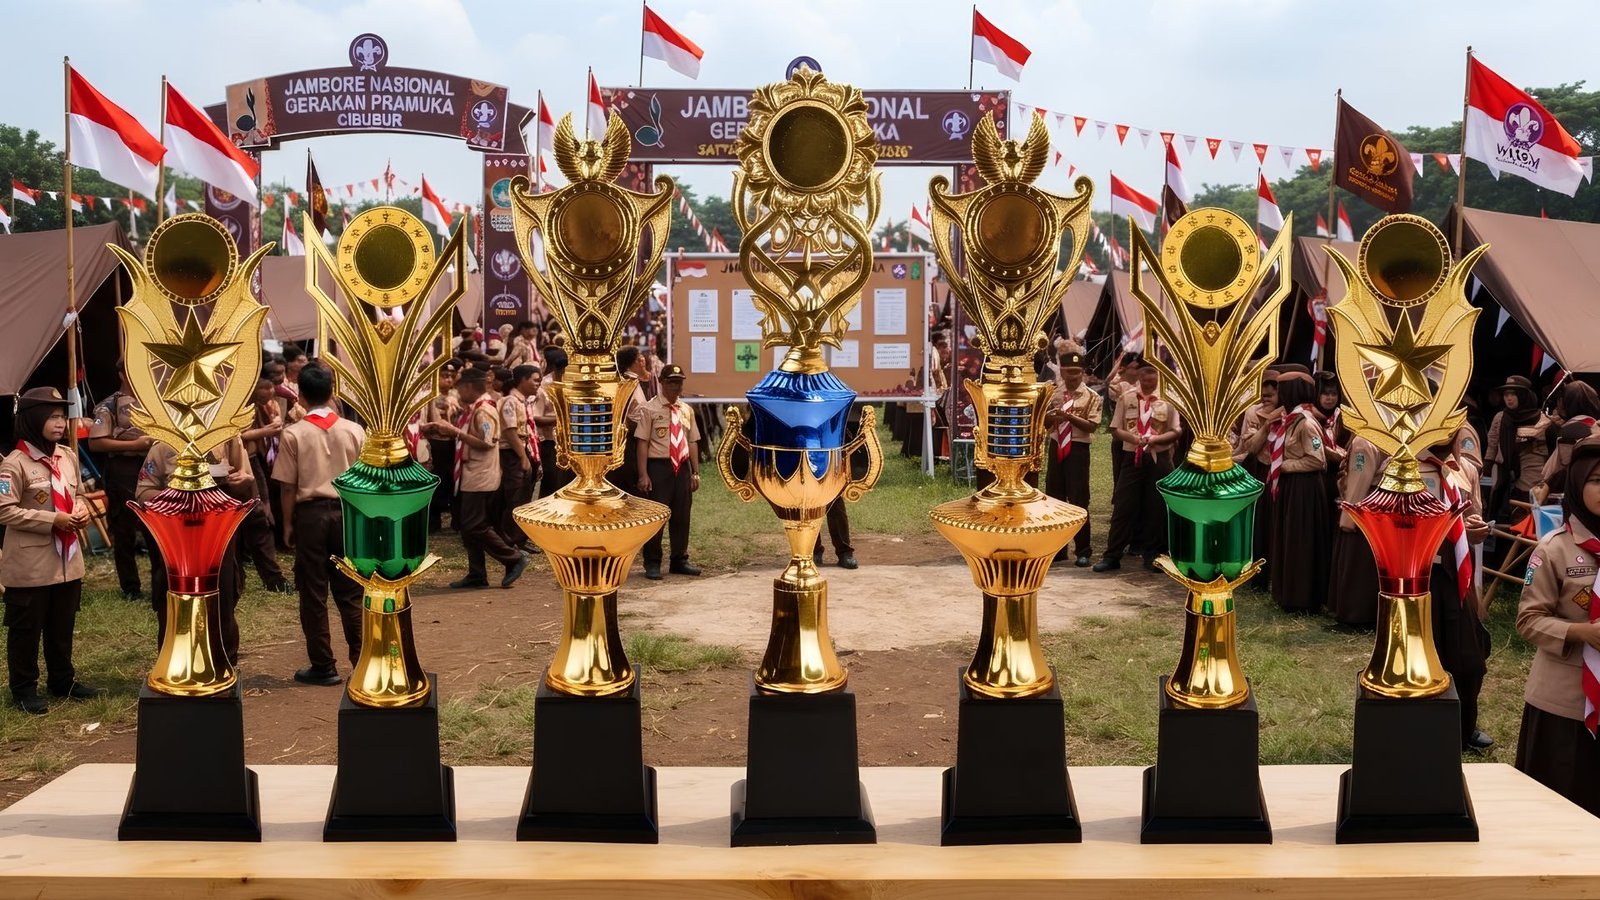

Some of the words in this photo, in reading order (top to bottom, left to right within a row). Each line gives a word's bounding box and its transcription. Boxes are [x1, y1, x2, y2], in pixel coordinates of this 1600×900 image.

[284, 76, 366, 96] JAMBORE
[370, 75, 455, 96] NASIONAL
[285, 94, 366, 114] GERAKAN
[371, 94, 454, 116] PRAMUKA
[680, 95, 749, 118] JAMB
[863, 96, 930, 119] ONAL
[337, 112, 403, 127] CIBUBUR
